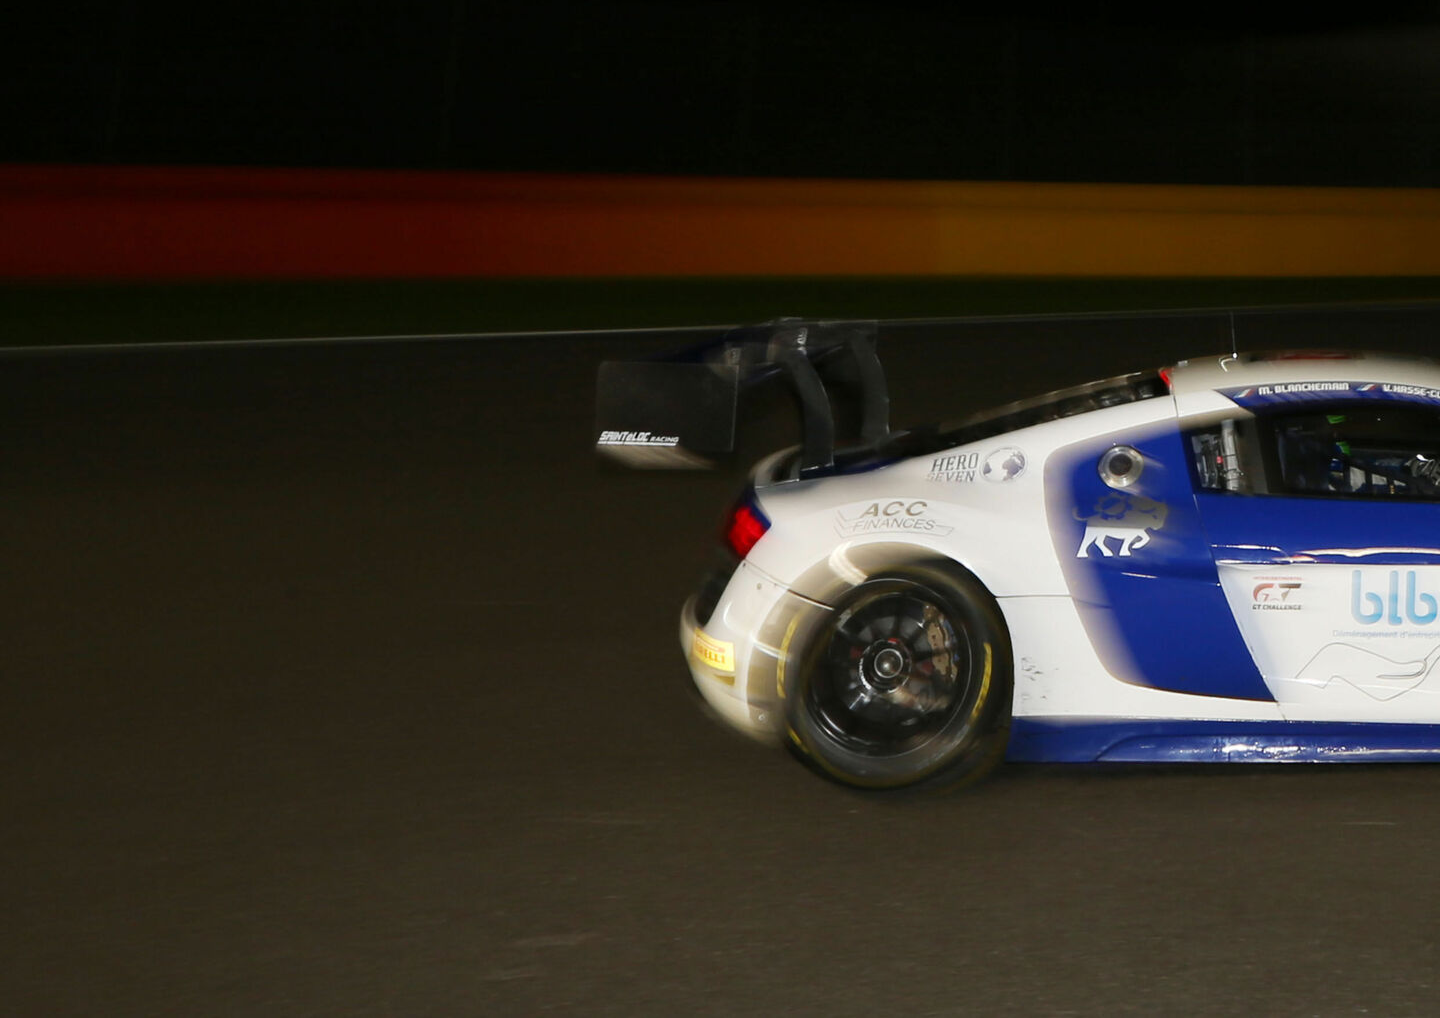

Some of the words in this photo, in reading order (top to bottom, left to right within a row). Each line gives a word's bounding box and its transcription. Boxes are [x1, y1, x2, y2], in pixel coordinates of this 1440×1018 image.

[1274, 382, 1350, 394] BLANCHEMAIN
[931, 452, 979, 472] HERO
[926, 470, 976, 482] SEVEN
[859, 501, 928, 518] ACC
[853, 517, 936, 532] FINANCES
[1351, 570, 1438, 625] blb
